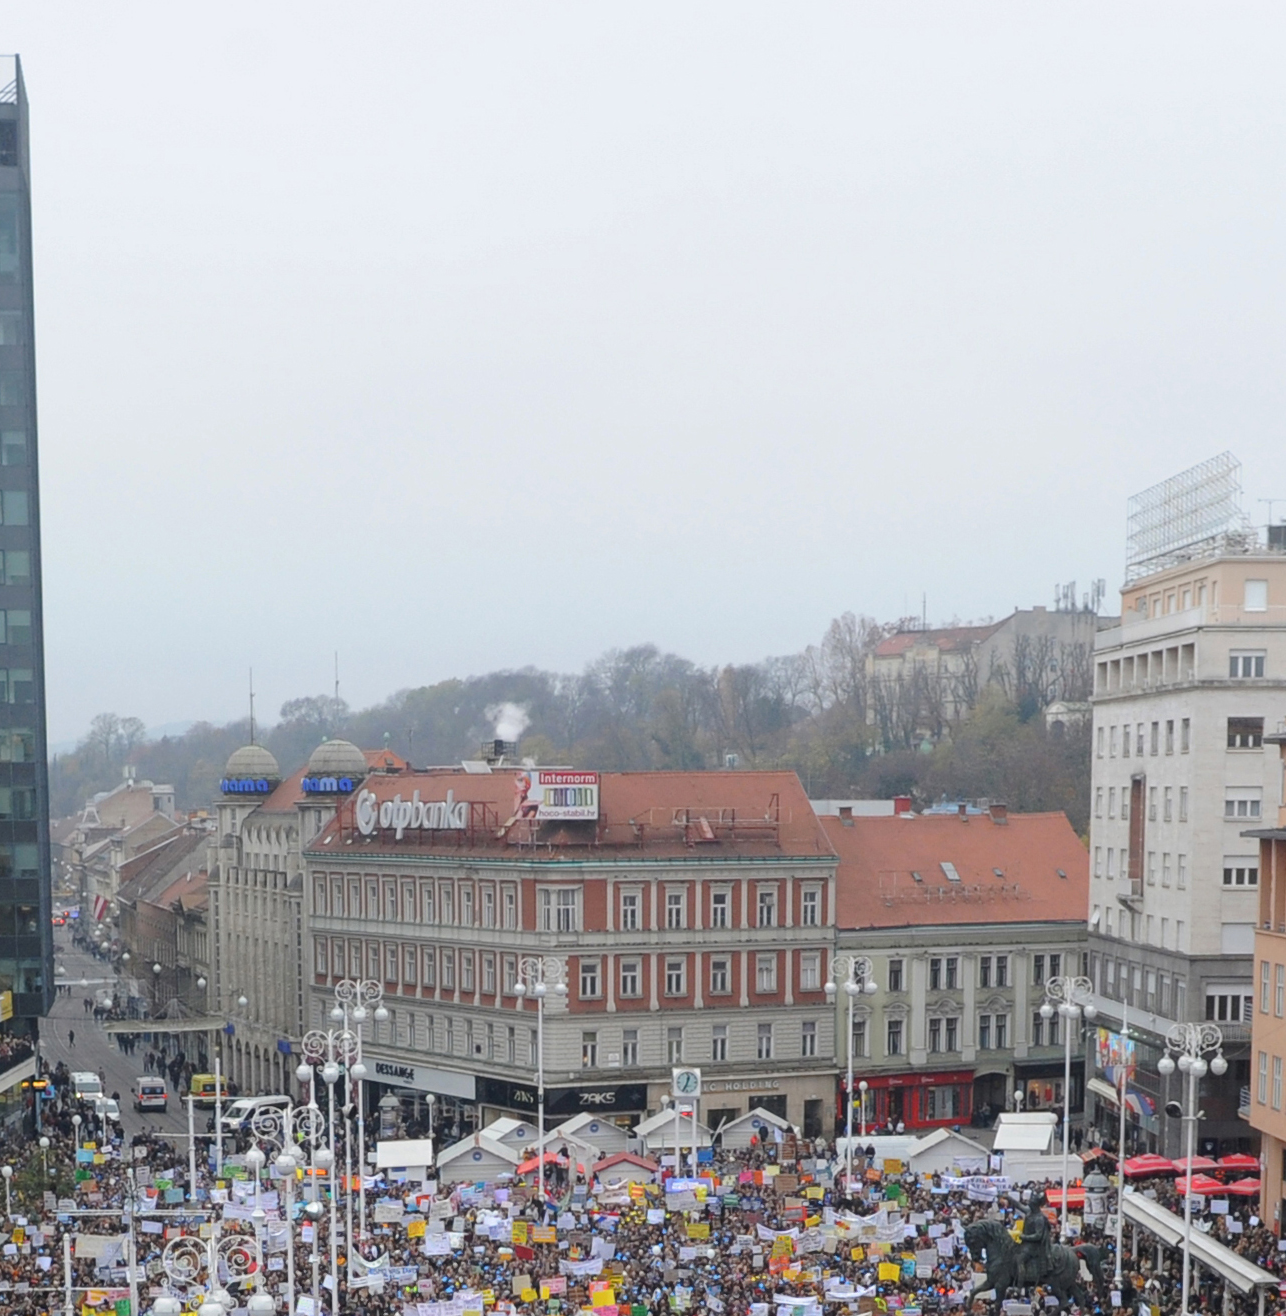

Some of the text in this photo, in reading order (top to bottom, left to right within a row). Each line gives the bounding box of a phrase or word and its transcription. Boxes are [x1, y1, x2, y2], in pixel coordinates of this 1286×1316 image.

[540, 773, 595, 783] Internorm
[725, 1081, 779, 1091] HOLDING
[579, 1092, 615, 1105] ZAKS
